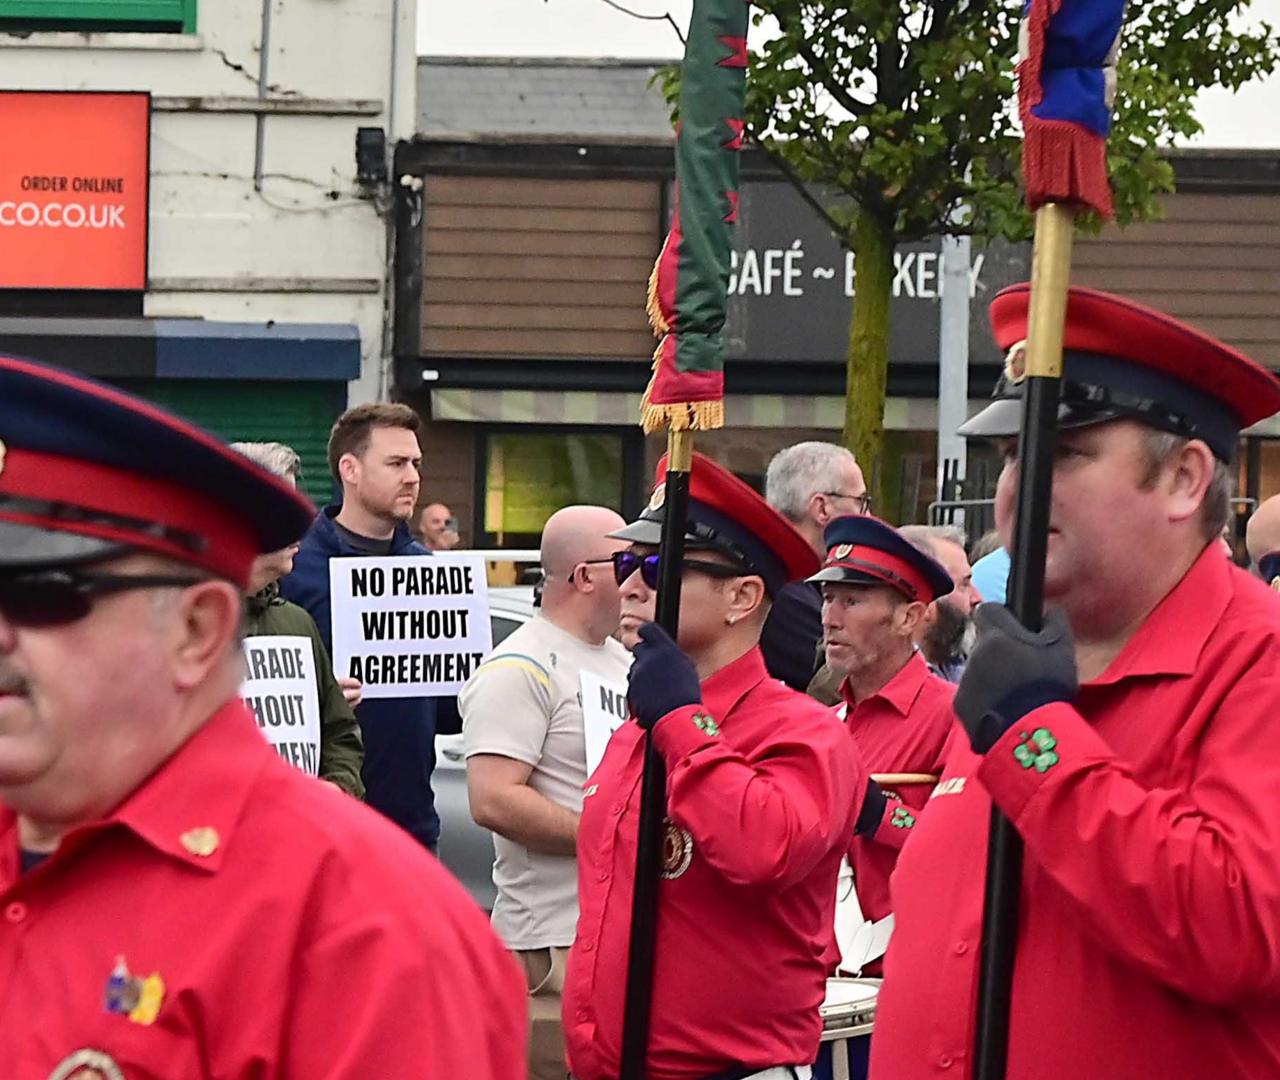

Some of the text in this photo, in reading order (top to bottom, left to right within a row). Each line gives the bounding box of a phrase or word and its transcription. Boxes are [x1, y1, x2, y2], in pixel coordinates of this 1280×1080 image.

[20, 175, 125, 194] ORDER ONLINE
[351, 566, 474, 597] NO PARADE
[361, 609, 469, 641] WITHOUT
[349, 652, 484, 685] AGREEMENT
